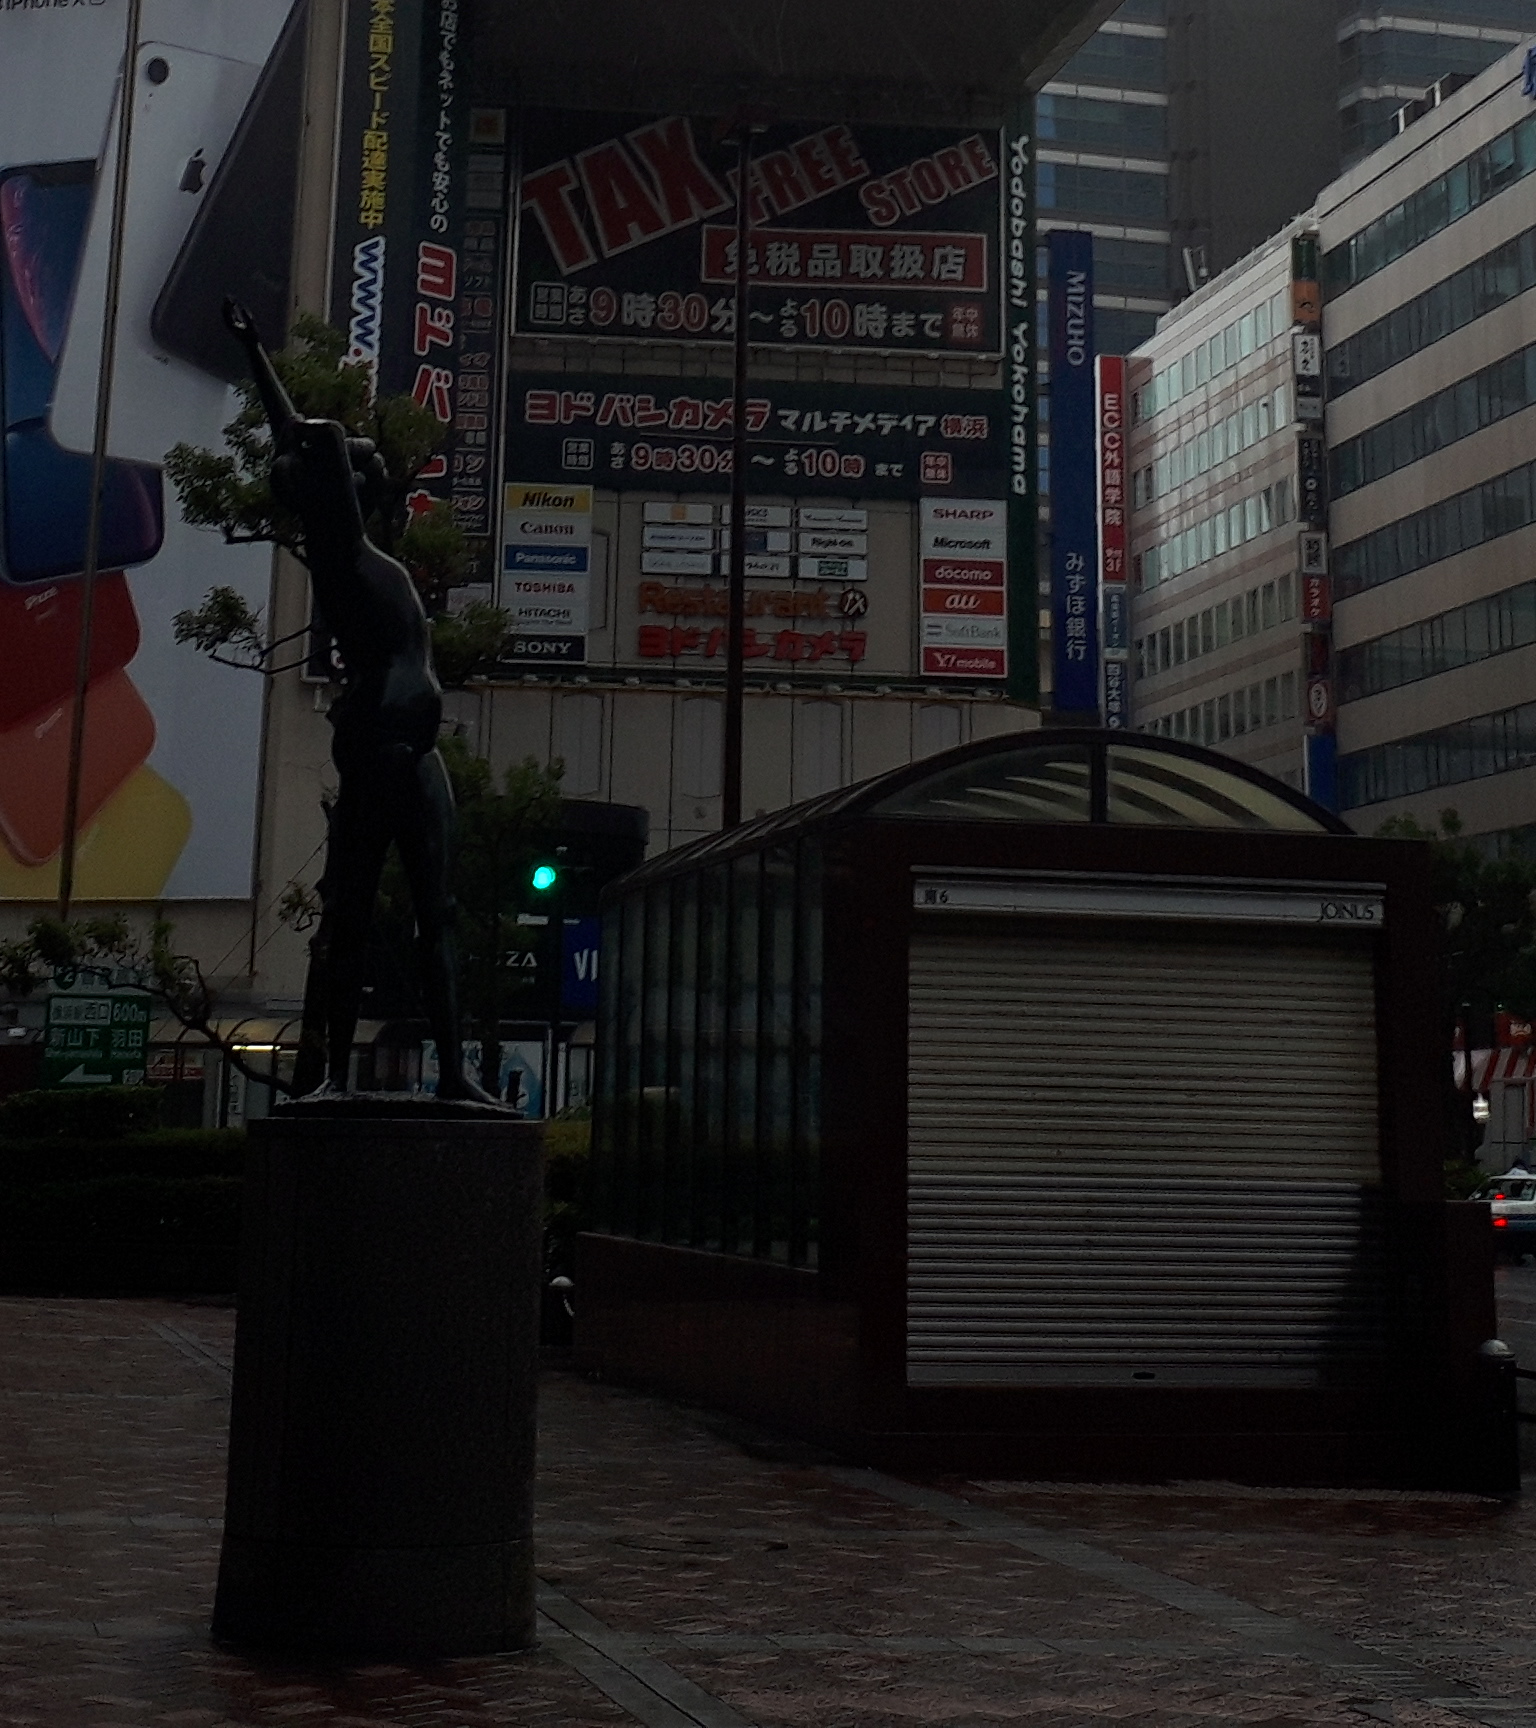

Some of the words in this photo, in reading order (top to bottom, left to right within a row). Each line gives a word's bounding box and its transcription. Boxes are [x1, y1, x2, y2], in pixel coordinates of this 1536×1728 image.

[520, 114, 736, 277] TAX
[726, 123, 870, 228] FREE
[858, 133, 999, 228] STORE
[1010, 133, 1030, 309] Yodobashi
[724, 239, 966, 282] 免税品取扱店
[1066, 270, 1087, 366] MIZUHO
[1010, 322, 1030, 497] Yokohama
[521, 492, 575, 509] Nikon
[933, 507, 994, 520] SHARP
[519, 521, 574, 536] Canon
[933, 536, 991, 551] Microsoft
[515, 550, 578, 565] Panasonic
[934, 565, 993, 581] docomo
[515, 582, 576, 594] TOSHIBA
[944, 591, 981, 609] au
[1065, 551, 1086, 661] みずほ銀行
[518, 606, 571, 619] HITACHI
[945, 622, 1001, 639] SoftBank
[513, 641, 573, 655] SONY
